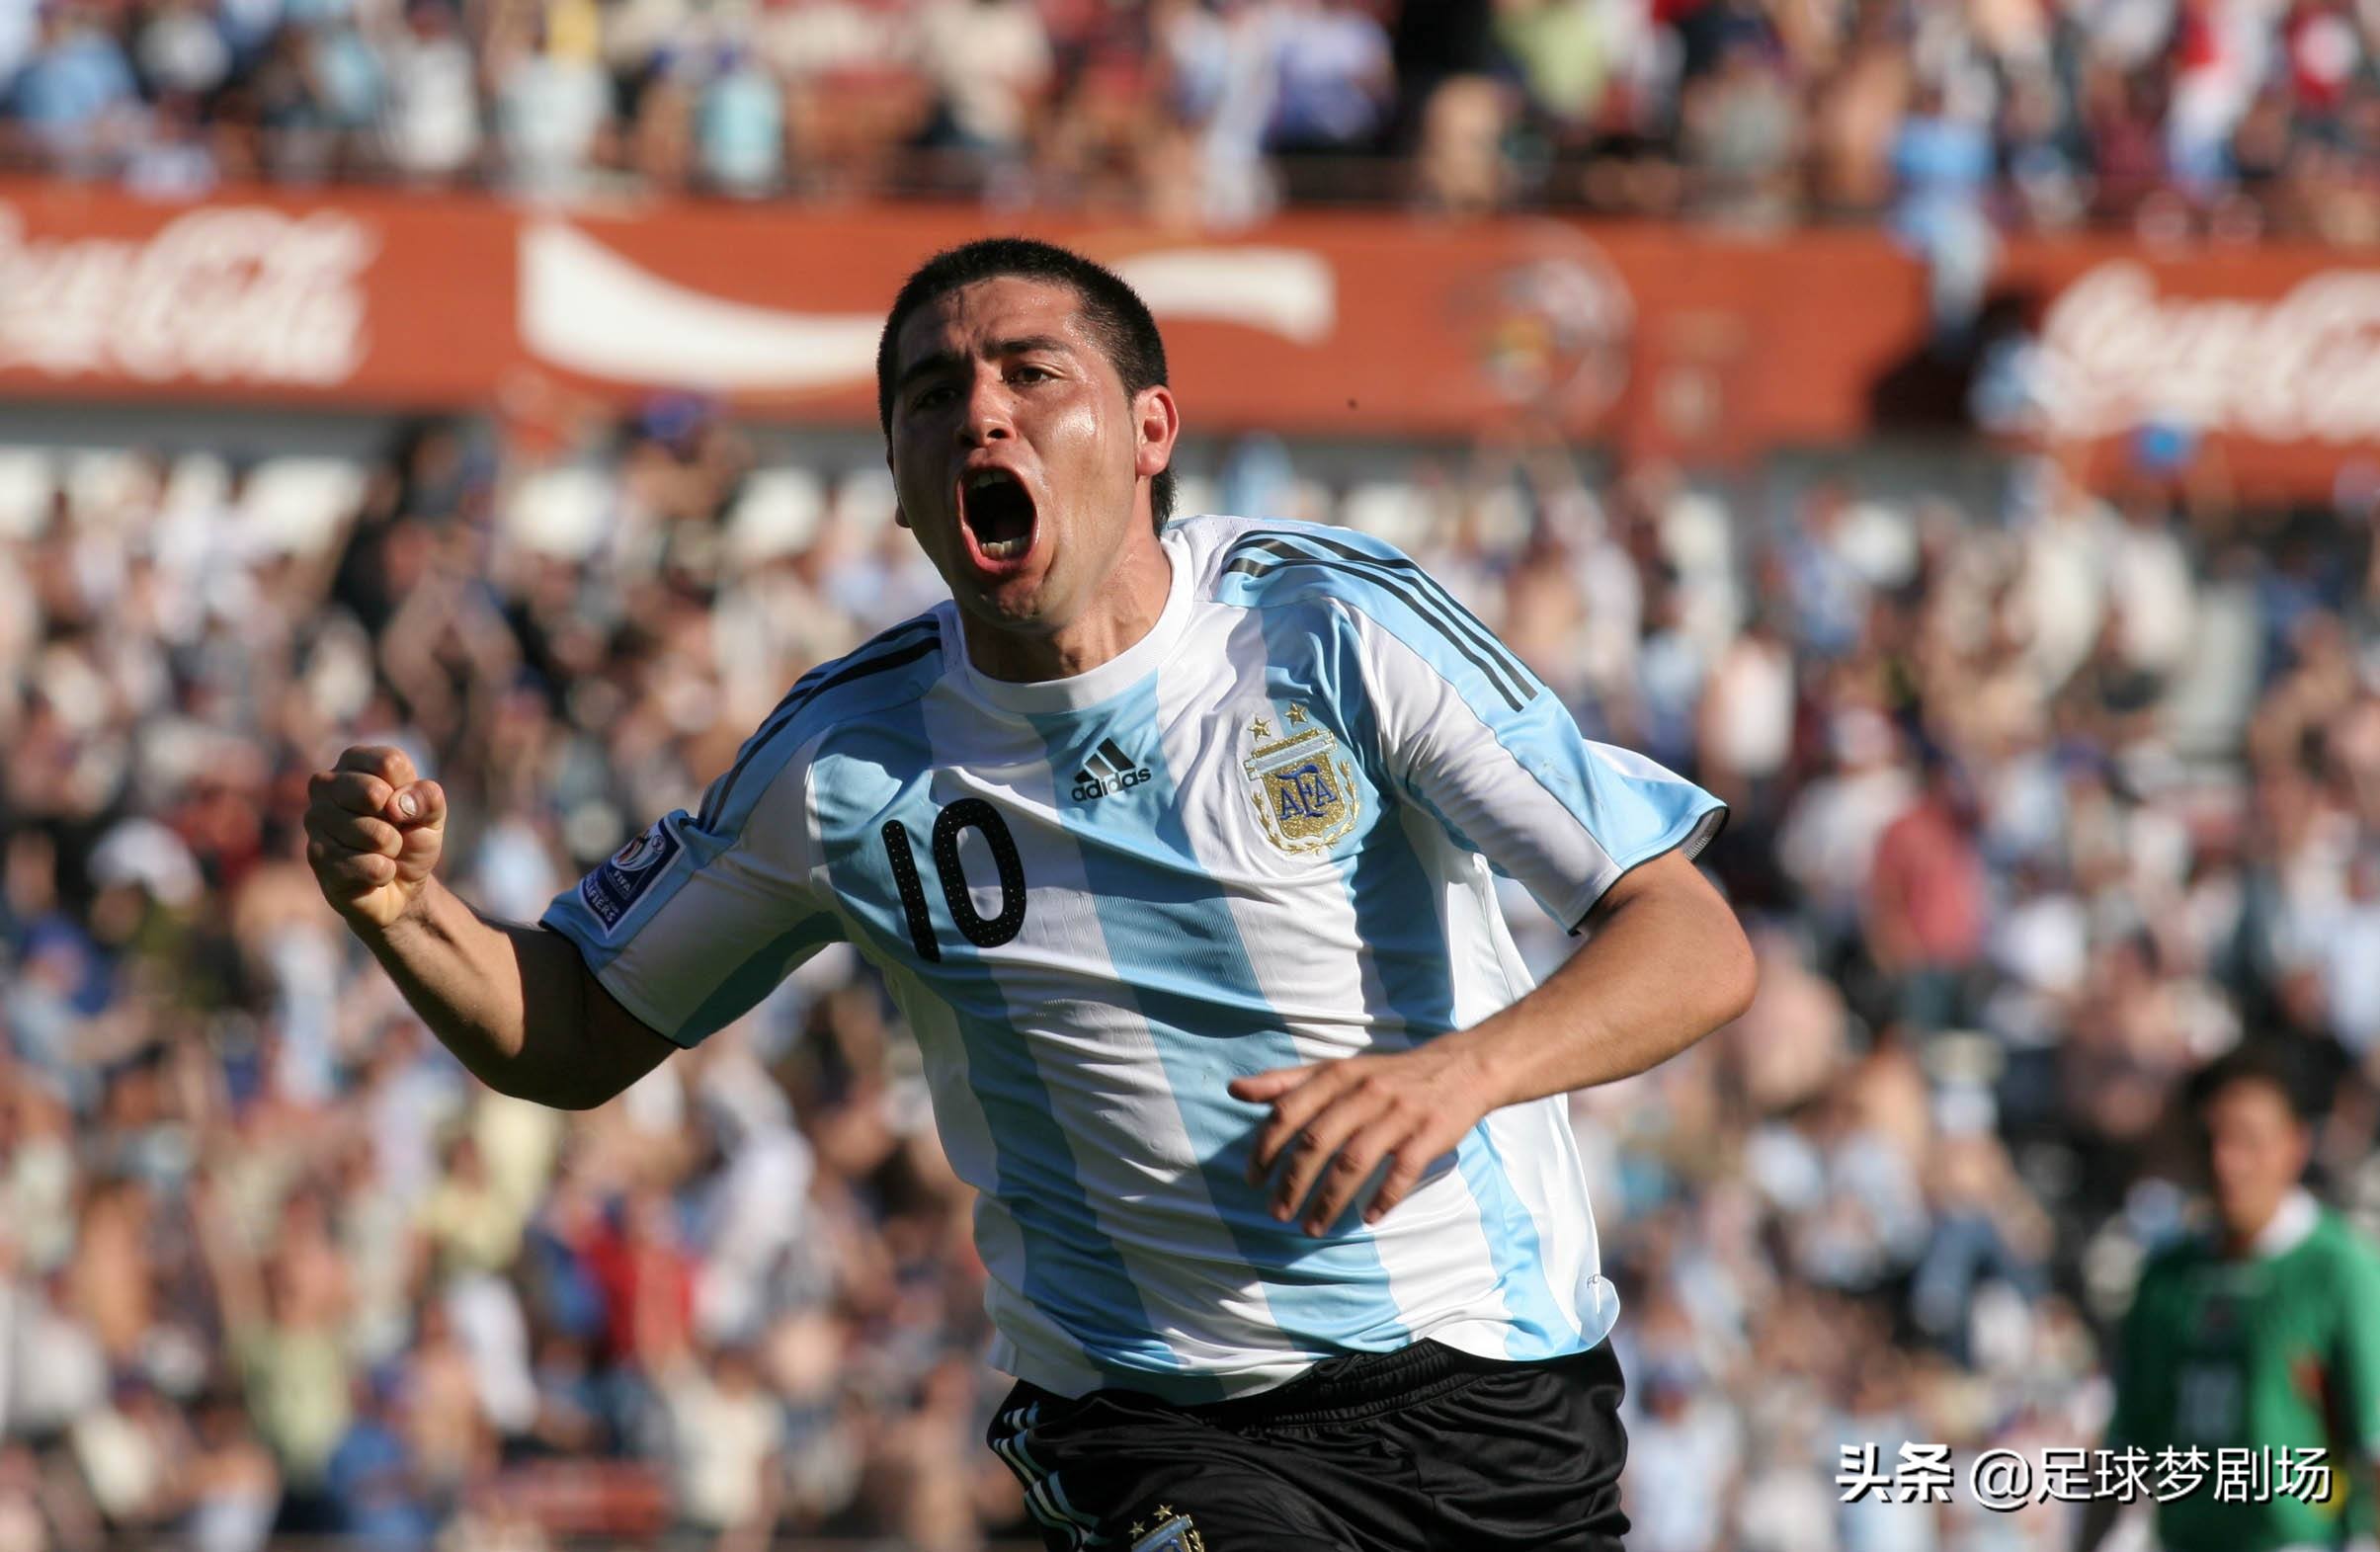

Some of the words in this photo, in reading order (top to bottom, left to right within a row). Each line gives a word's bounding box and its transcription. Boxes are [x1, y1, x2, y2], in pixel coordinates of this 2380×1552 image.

[1071, 768, 1152, 802] adidas
[1276, 764, 1337, 821] AFA
[614, 870, 631, 891] FIFA
[881, 797, 1026, 963] 10
